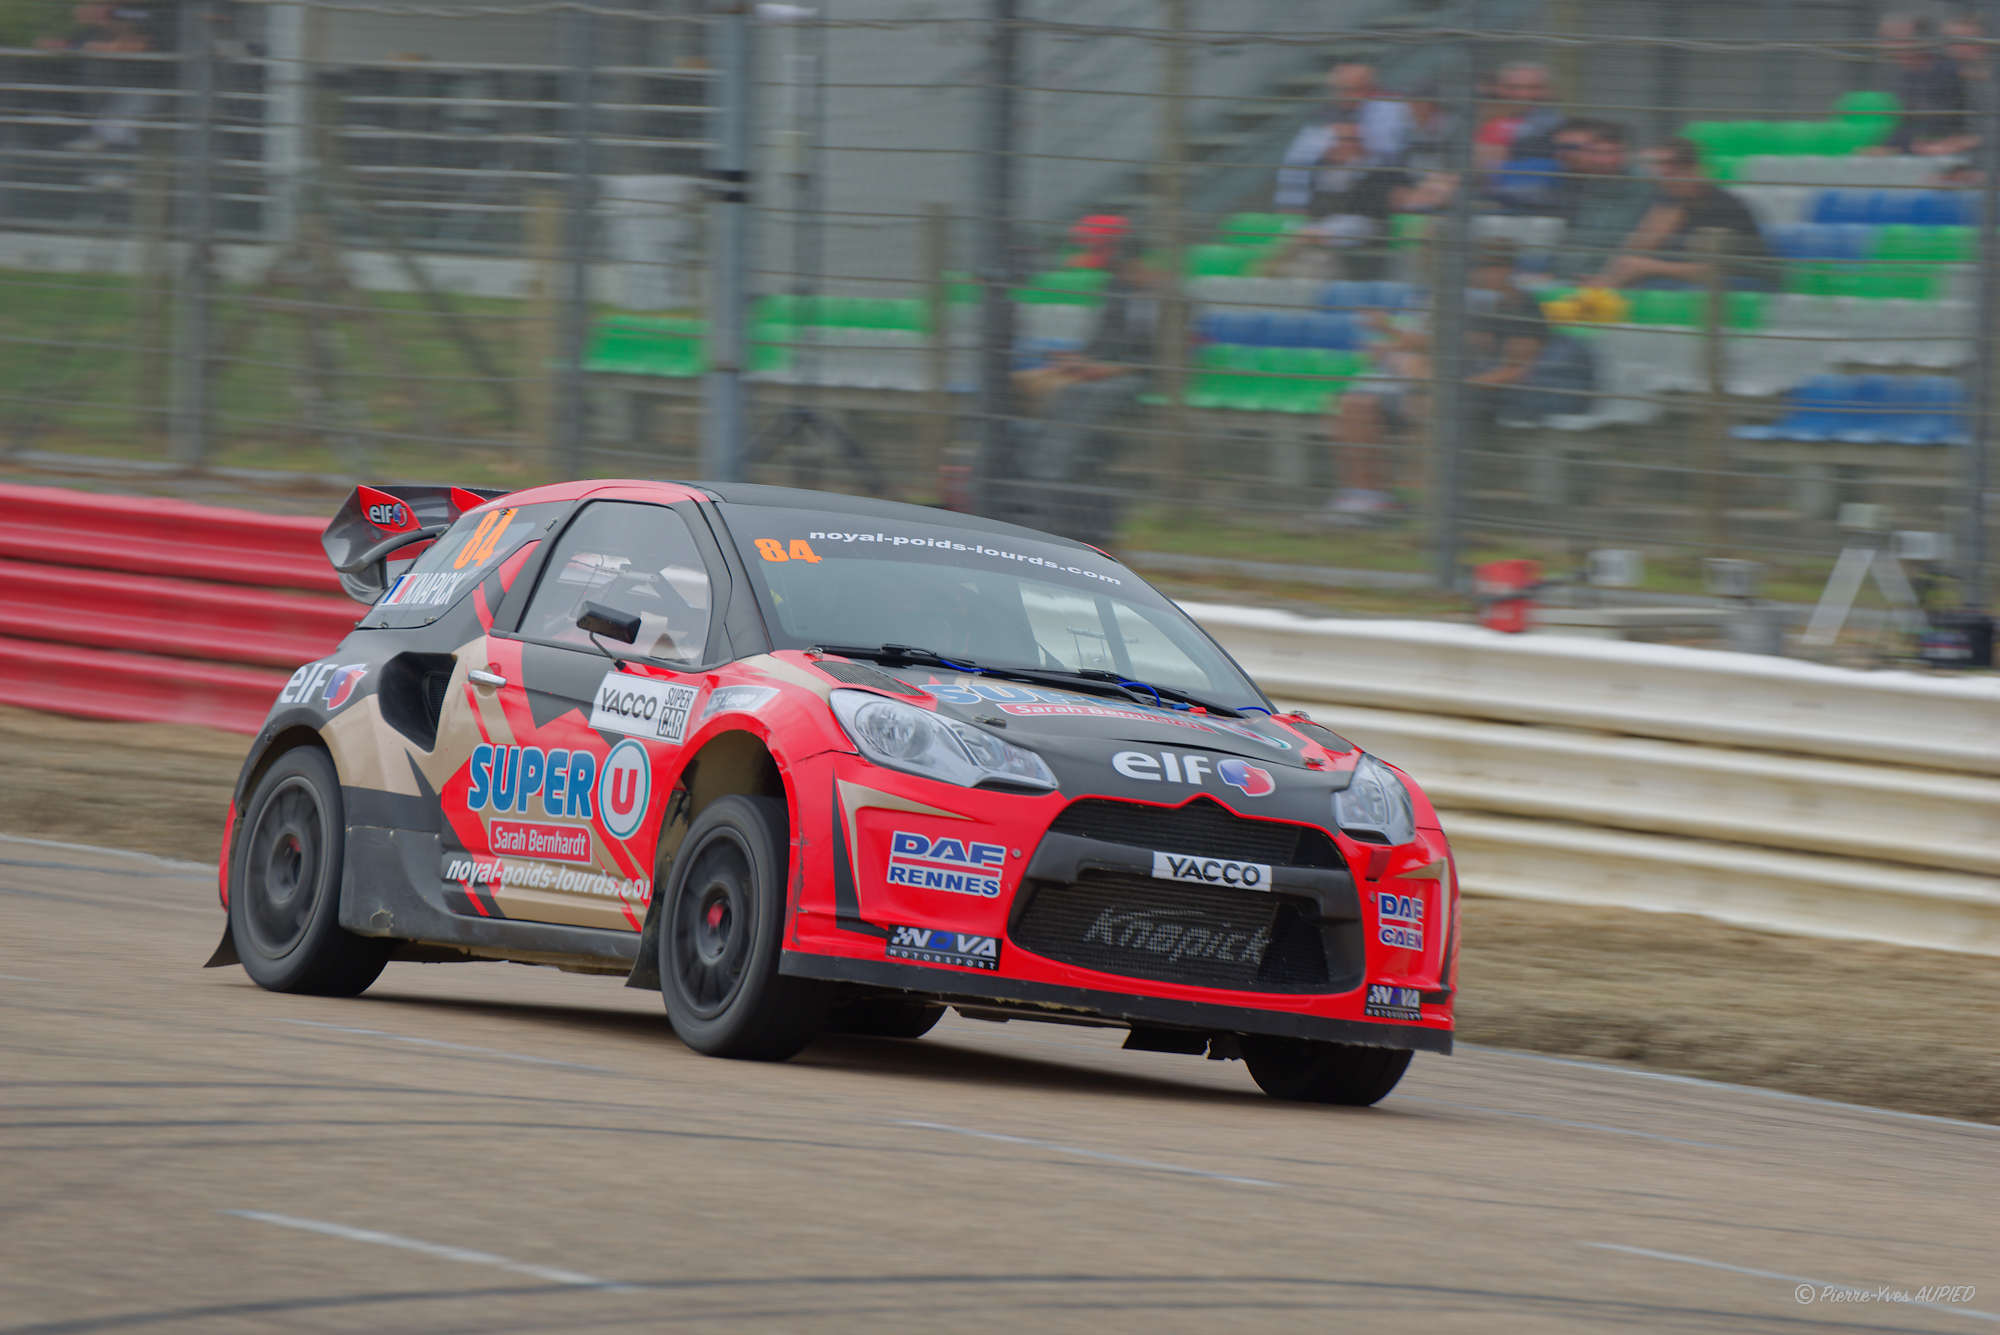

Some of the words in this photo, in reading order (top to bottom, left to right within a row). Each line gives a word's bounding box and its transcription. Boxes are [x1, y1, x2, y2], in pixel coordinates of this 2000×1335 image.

[369, 504, 393, 524] elf
[453, 508, 519, 570] 84
[754, 538, 823, 564] 84
[810, 530, 1121, 586] noyal-poids-lourds.com
[280, 663, 338, 704] elf
[667, 687, 694, 707] SUPER
[600, 687, 657, 720] YACCO
[659, 708, 683, 738] CAR
[467, 743, 596, 820] SUPER
[611, 768, 638, 816] U
[1112, 751, 1212, 786] elf
[494, 826, 525, 852] Sarah
[528, 827, 586, 857] Bernhardt
[893, 831, 1006, 865] DAF
[889, 866, 1000, 896] RENNES
[1167, 856, 1261, 886] YACCO
[1380, 894, 1424, 920] DAF
[892, 926, 997, 957] NOVA
[1381, 928, 1422, 949] CAEN
[890, 948, 995, 970] MOTORSPORT
[1368, 984, 1420, 1008] NOVA
